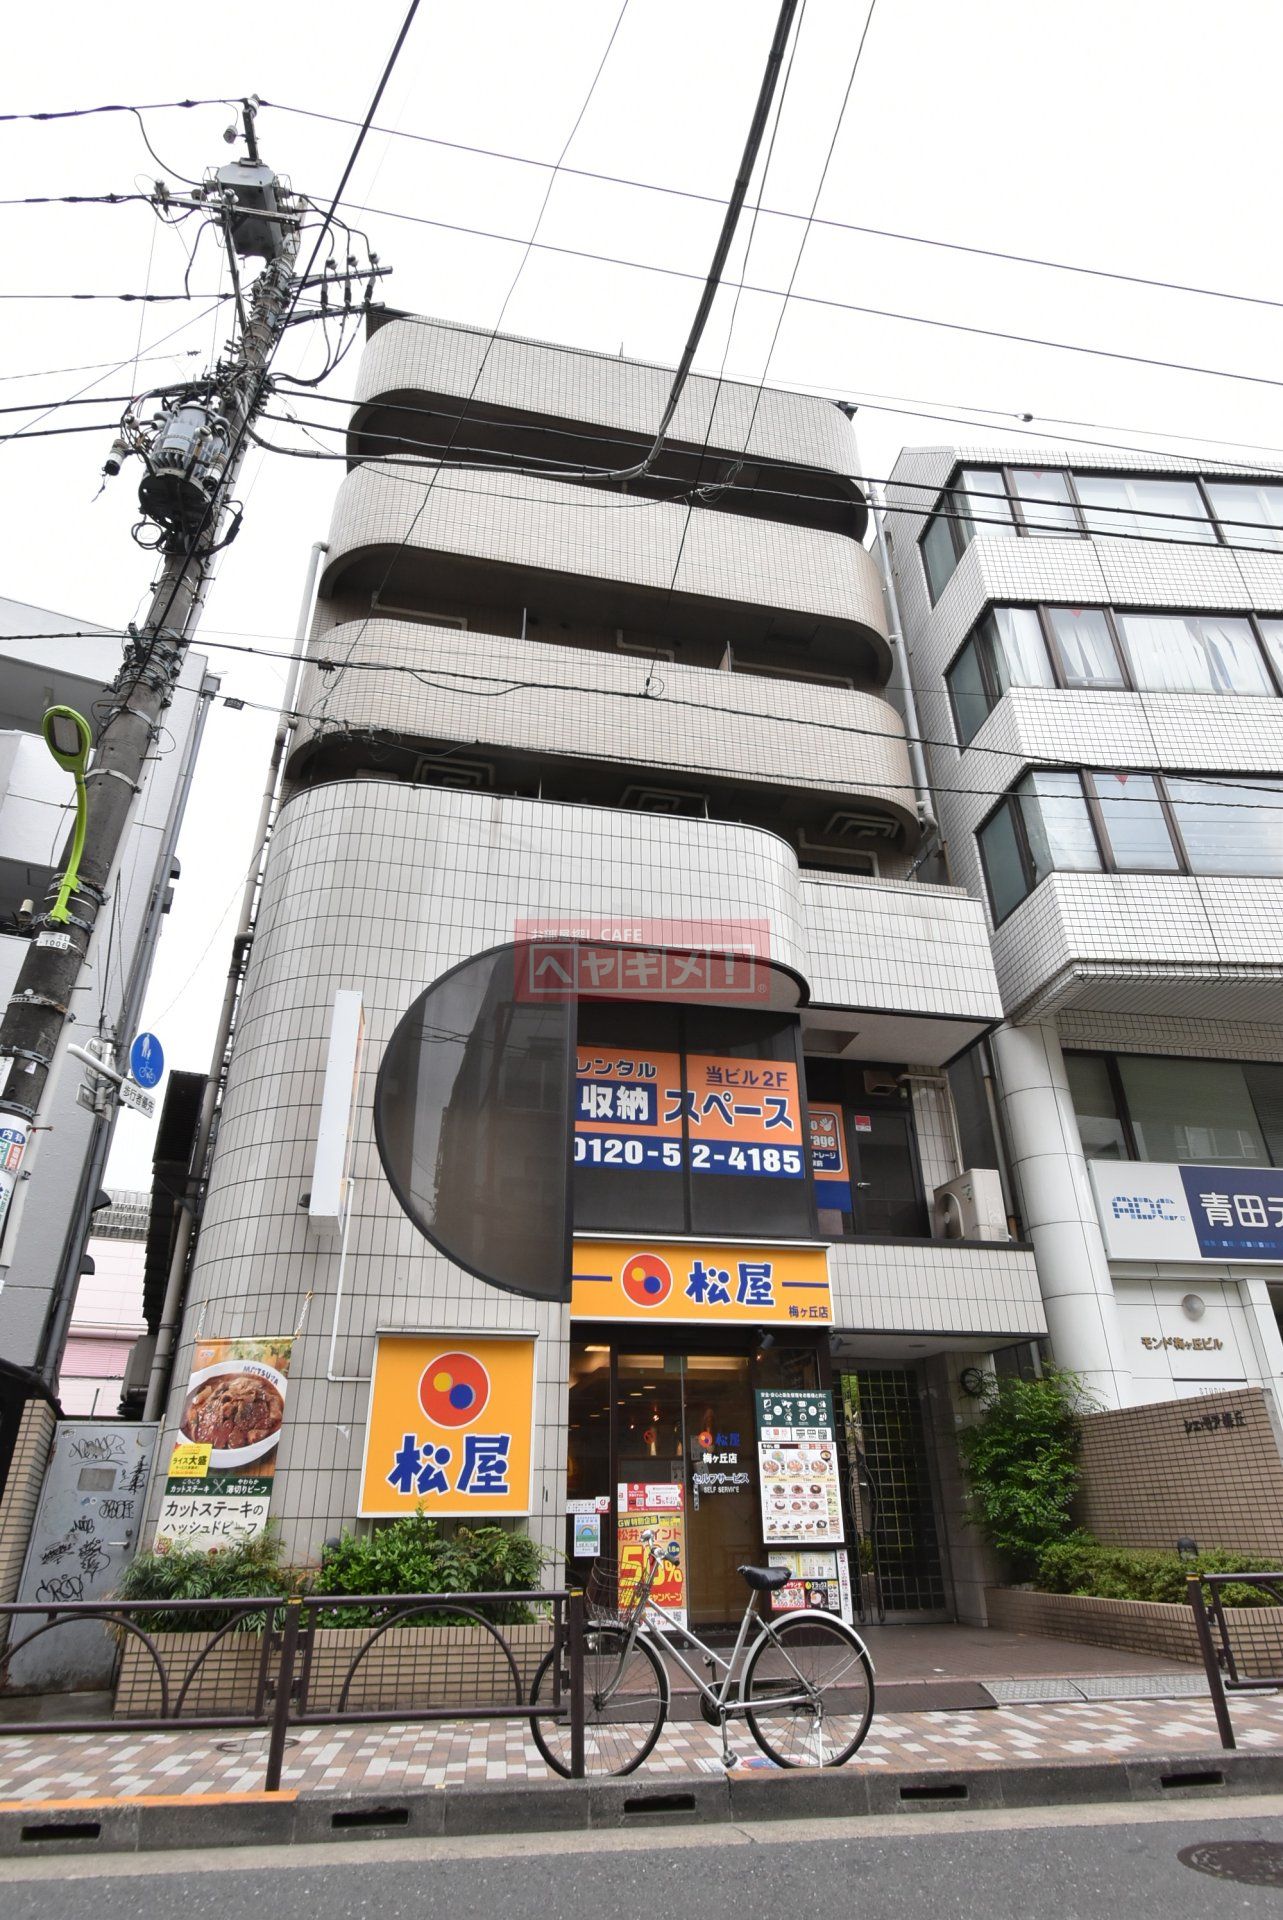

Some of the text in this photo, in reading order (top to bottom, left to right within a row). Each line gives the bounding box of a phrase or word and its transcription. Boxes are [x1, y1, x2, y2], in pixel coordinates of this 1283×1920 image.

[576, 1057, 657, 1079] レンタル
[706, 1065, 788, 1088] 当ビル2F
[123, 1086, 154, 1114] 歩行者優先
[685, 1260, 776, 1307] 松屋
[386, 1432, 512, 1496] 松屋
[169, 1485, 210, 1494] カットステーキ
[692, 1472, 750, 1485] セルフサービス
[164, 1500, 264, 1519] カットステーキの
[162, 1520, 258, 1536] ハッシュドビーフ
